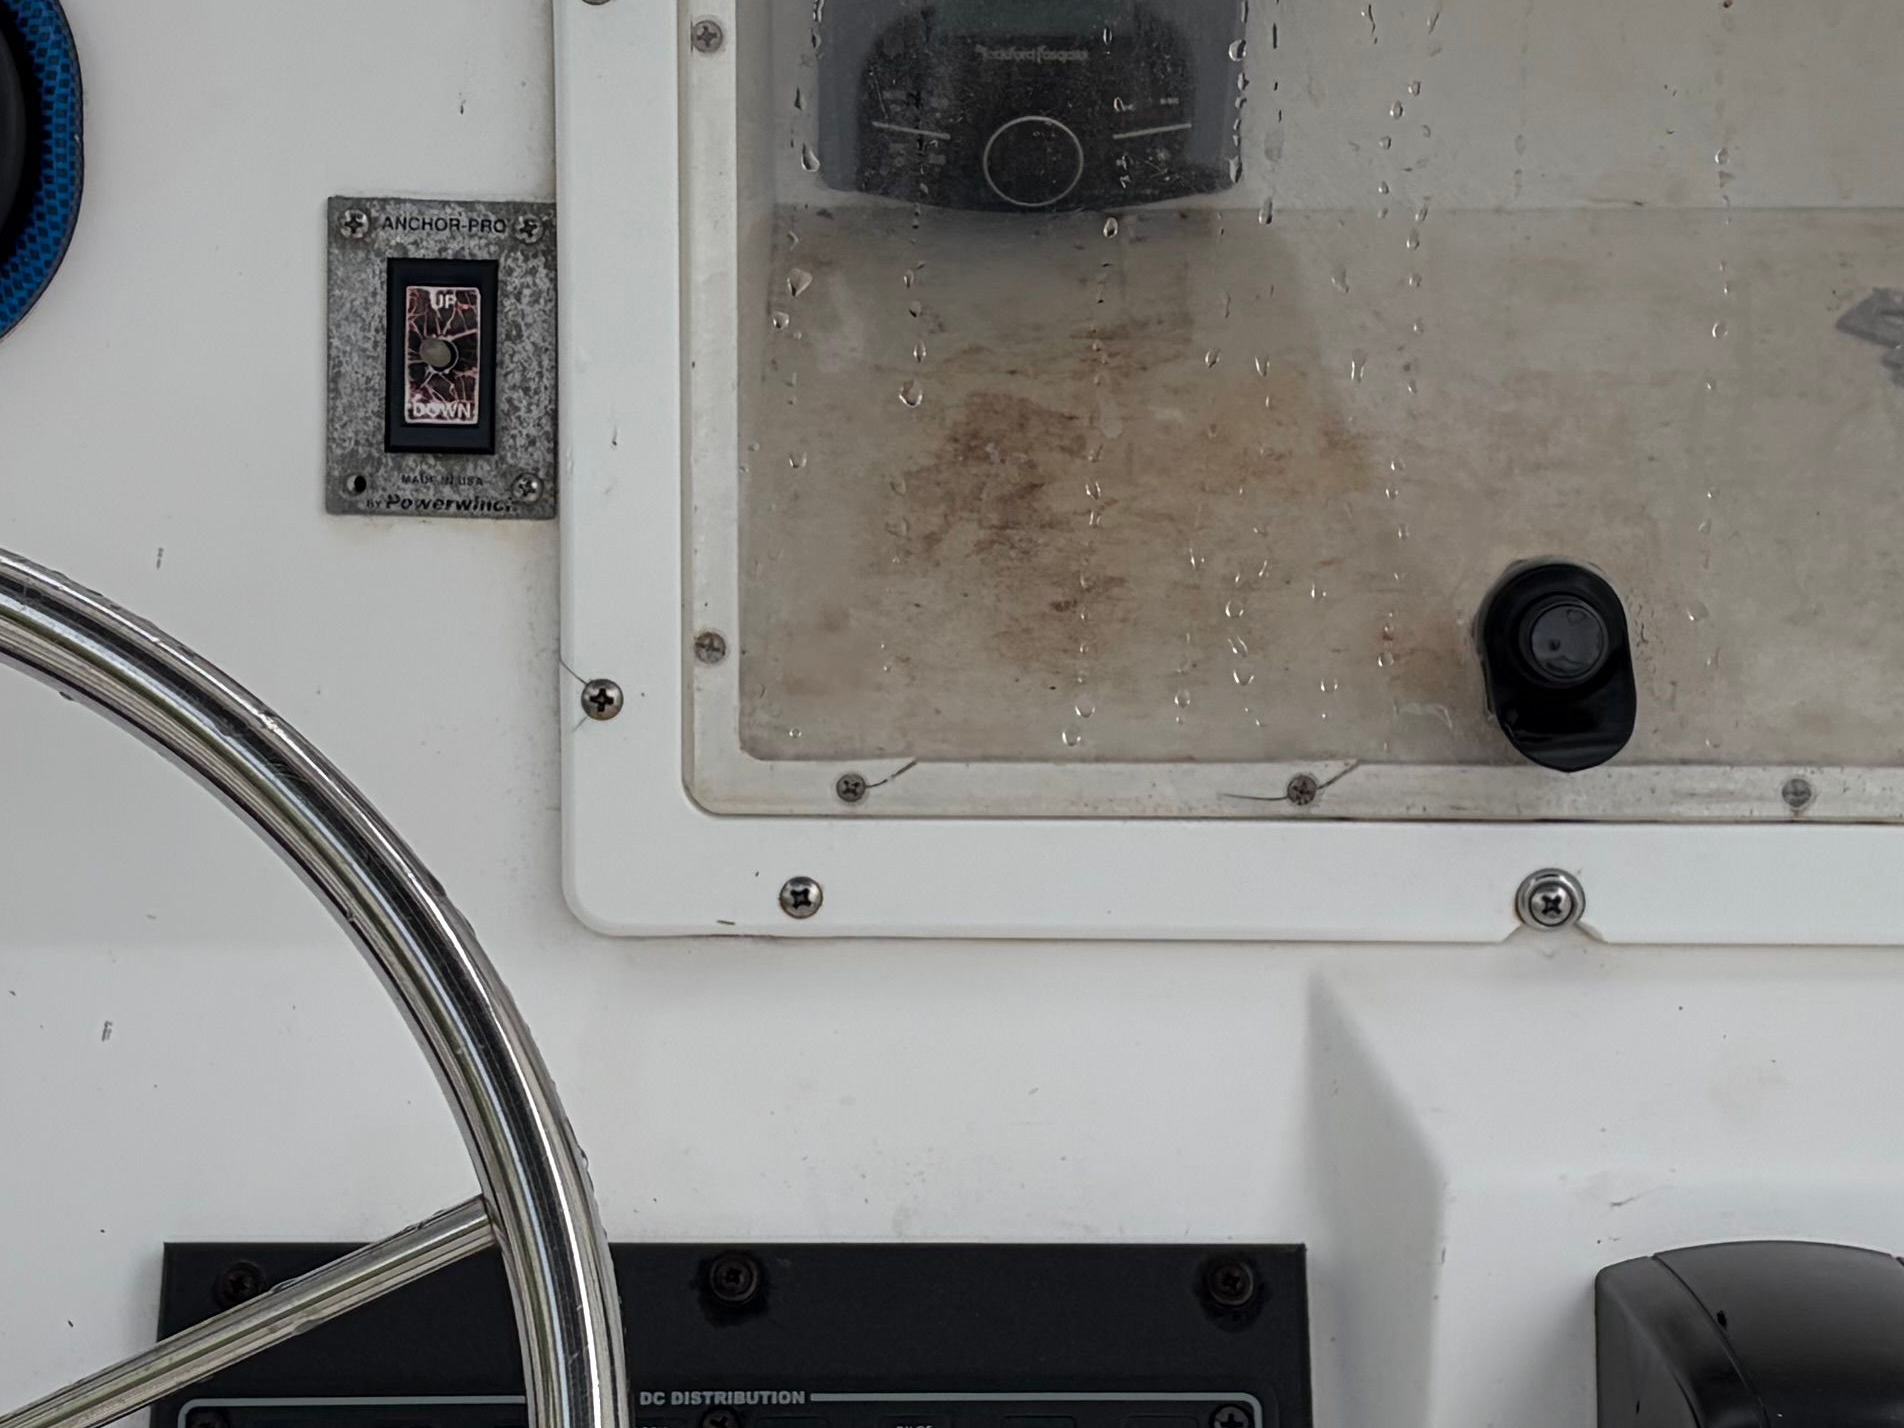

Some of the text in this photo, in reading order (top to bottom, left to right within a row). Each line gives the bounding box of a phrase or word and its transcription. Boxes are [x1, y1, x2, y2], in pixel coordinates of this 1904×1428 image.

[382, 215, 507, 233] ANCHOR-PRO
[429, 293, 458, 310] UP
[412, 401, 472, 419] DOWN
[401, 473, 434, 485] MADE
[458, 475, 484, 486] USA
[366, 499, 381, 509] BY
[639, 1390, 806, 1406] DC DISTRIBUTION
